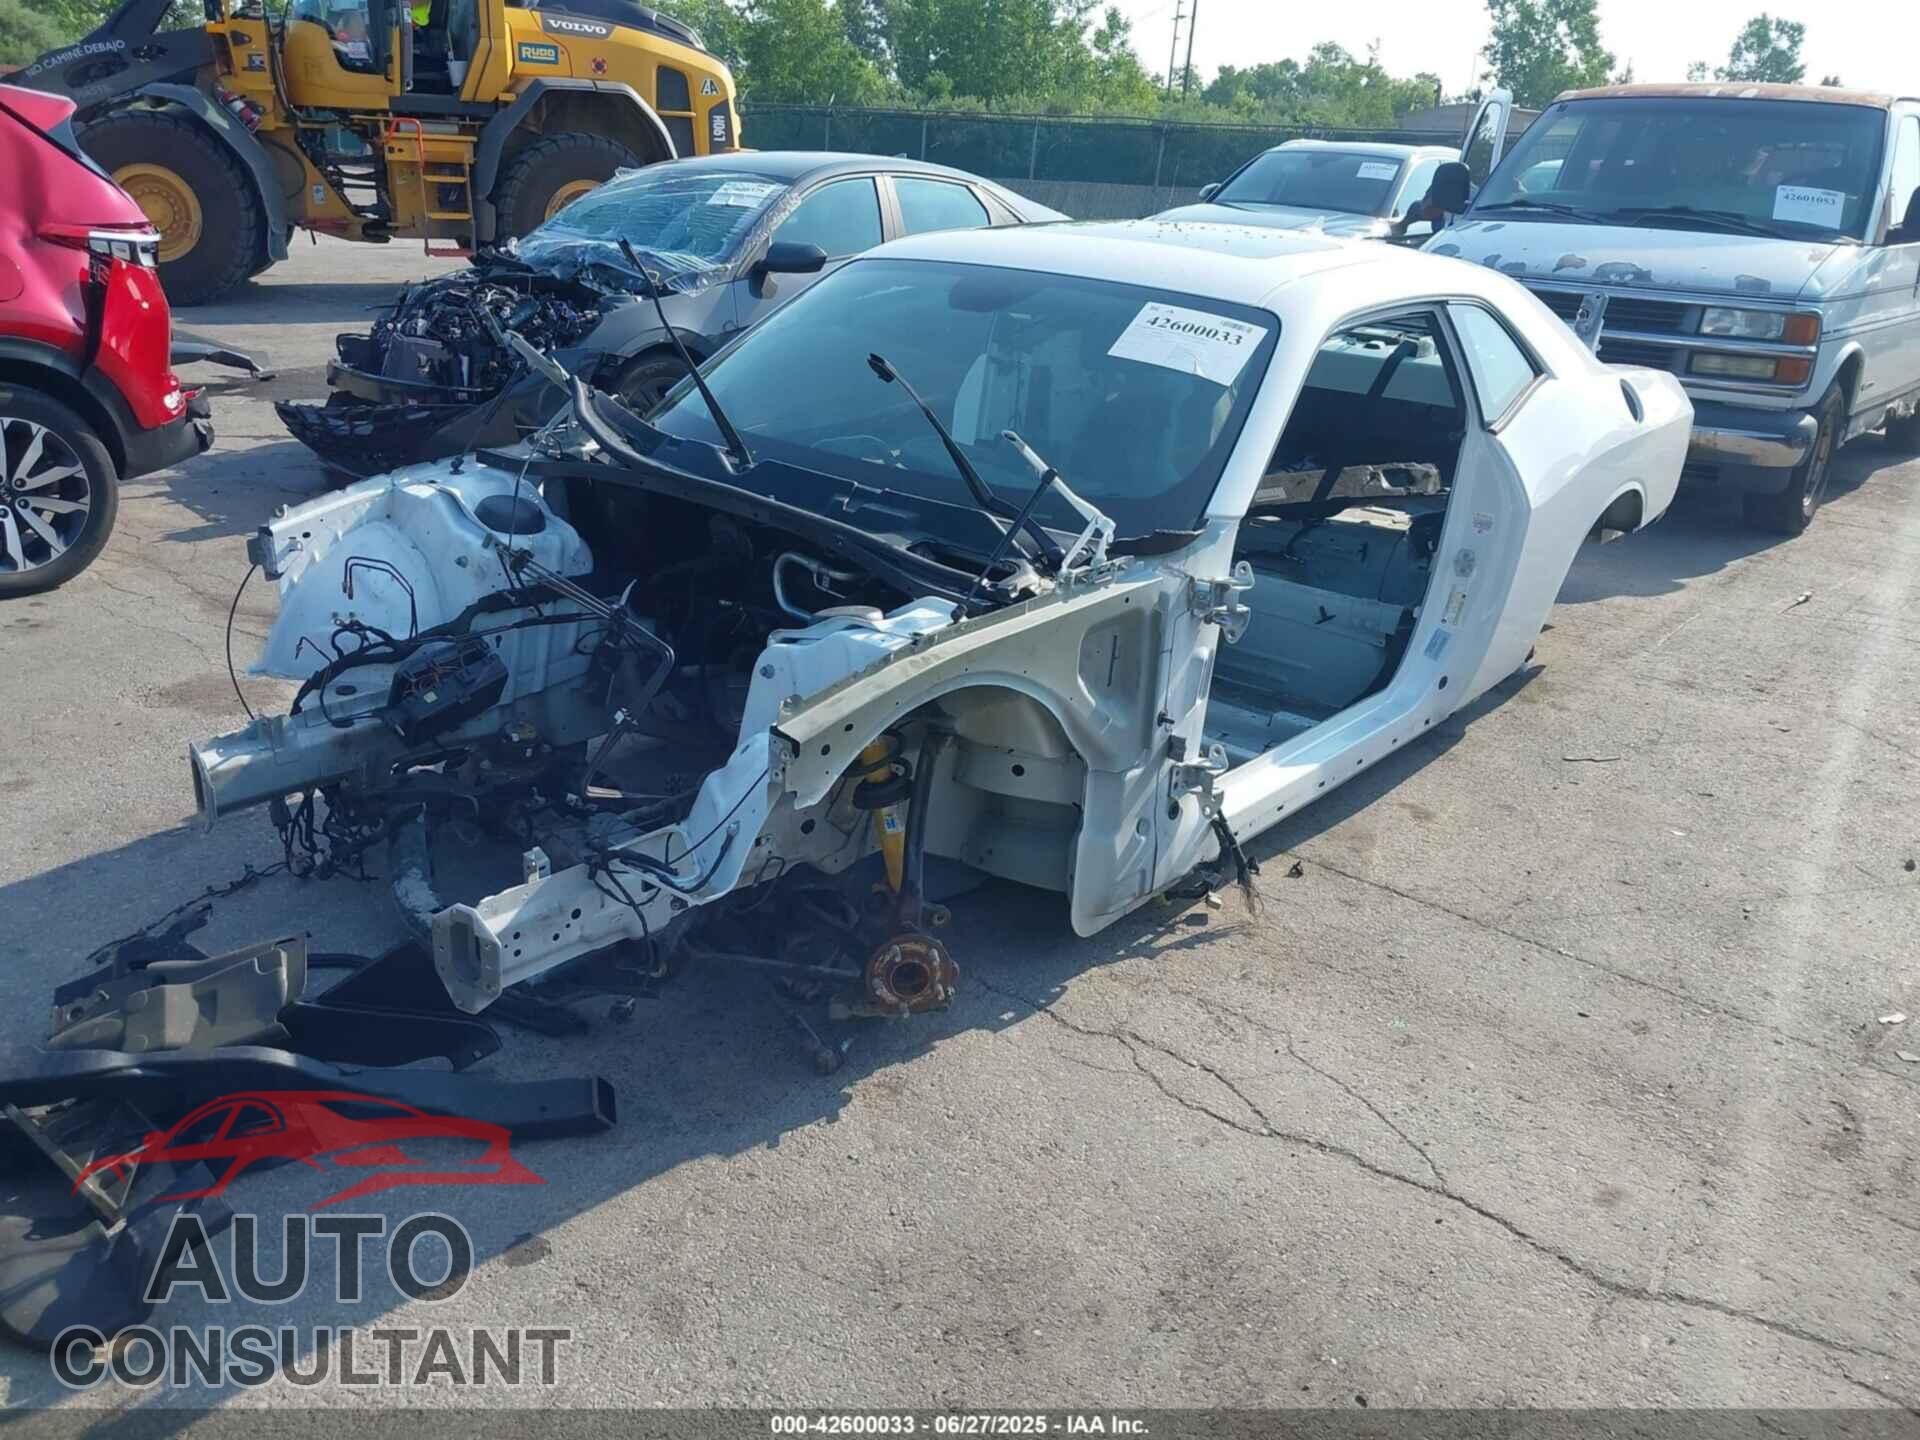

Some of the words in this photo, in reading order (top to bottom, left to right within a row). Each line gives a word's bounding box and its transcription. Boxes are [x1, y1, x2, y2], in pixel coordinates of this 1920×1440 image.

[546, 18, 607, 35] VOLVO
[42, 49, 82, 69] CAMINE
[83, 39, 126, 53] DEBAJO
[712, 114, 726, 142] L90H
[1146, 315, 1243, 346] 42600033
